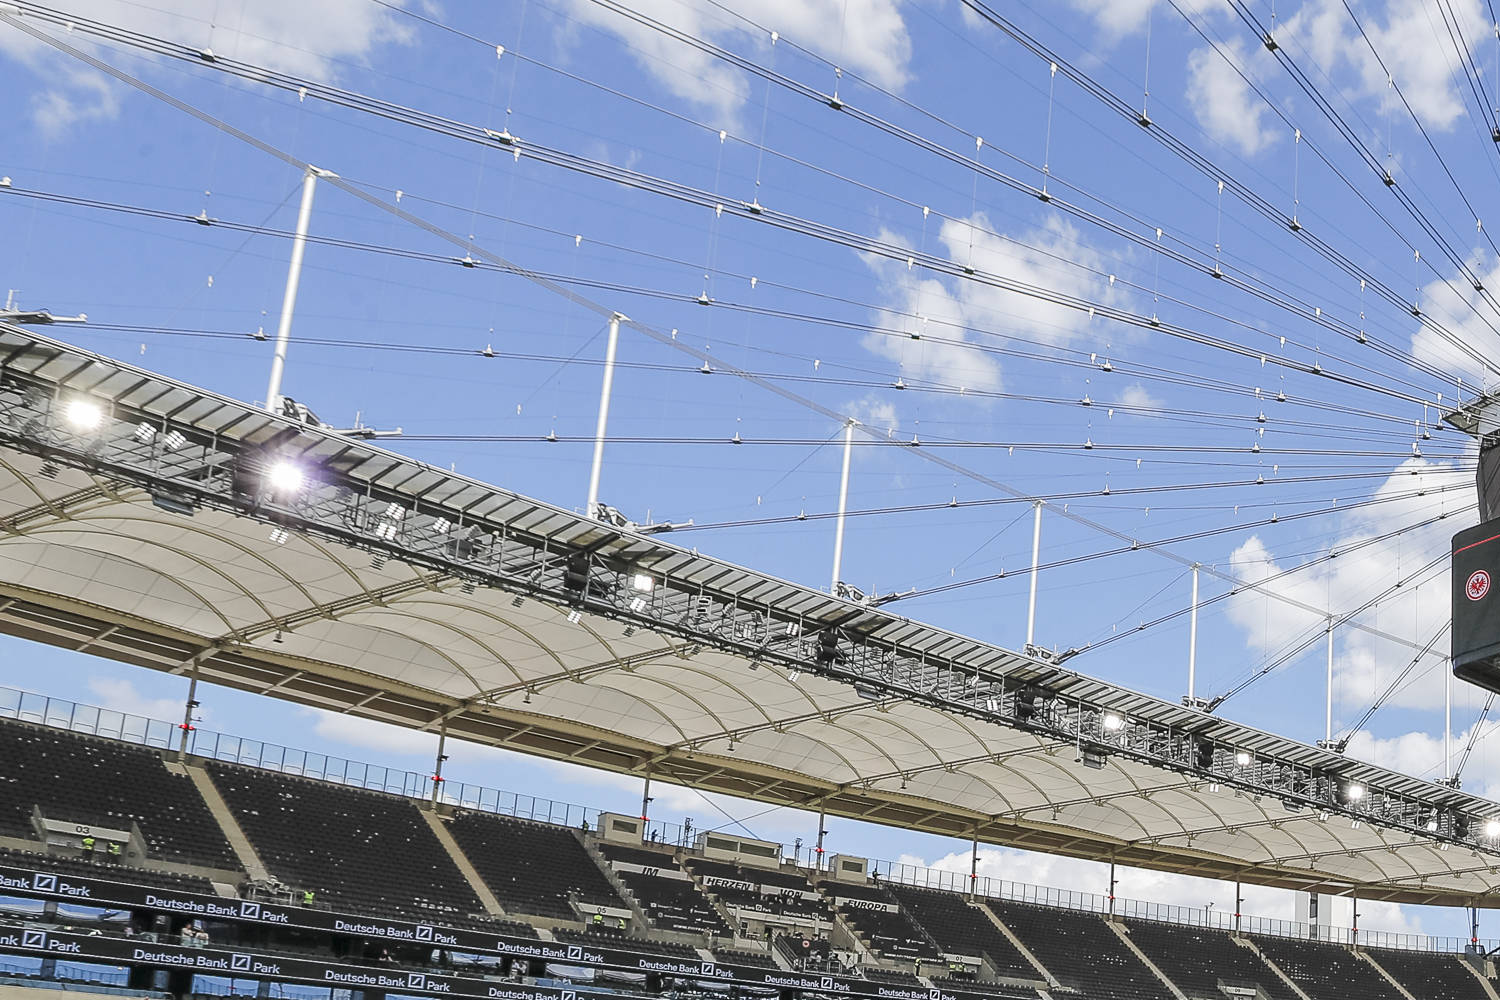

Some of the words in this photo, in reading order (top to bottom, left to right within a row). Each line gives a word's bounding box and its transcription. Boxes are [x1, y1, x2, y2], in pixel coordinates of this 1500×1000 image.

[75, 825, 90, 834] 03
[642, 867, 659, 877] IM
[59, 883, 91, 897] Park
[706, 877, 751, 891] HERZEN
[780, 888, 804, 898] VON
[146, 895, 204, 913] Deutsche
[207, 903, 237, 917] Bank
[262, 910, 288, 924] Park
[849, 900, 888, 912] EUROPA
[335, 920, 385, 936] Deutsche
[388, 927, 413, 939] Bank
[434, 933, 457, 945] Park
[48, 939, 81, 953] Park
[498, 941, 541, 956] Deutsche
[543, 947, 566, 959] Bank
[584, 952, 604, 963] Park
[134, 950, 194, 966] Deutsche
[197, 956, 228, 969] Bank
[253, 961, 280, 974] Park
[640, 959, 678, 972] Deutsche
[680, 964, 700, 975] Bank
[716, 967, 734, 978] Park
[325, 970, 376, 985] Deutsche
[379, 976, 405, 988] Bank
[426, 981, 450, 992] Park
[765, 975, 800, 986] Deutsche
[802, 978, 820, 988] Bank
[834, 981, 850, 991] Park
[489, 987, 534, 1000] Deutsche
[879, 988, 911, 998] Deutsche
[912, 991, 929, 1000] Bank
